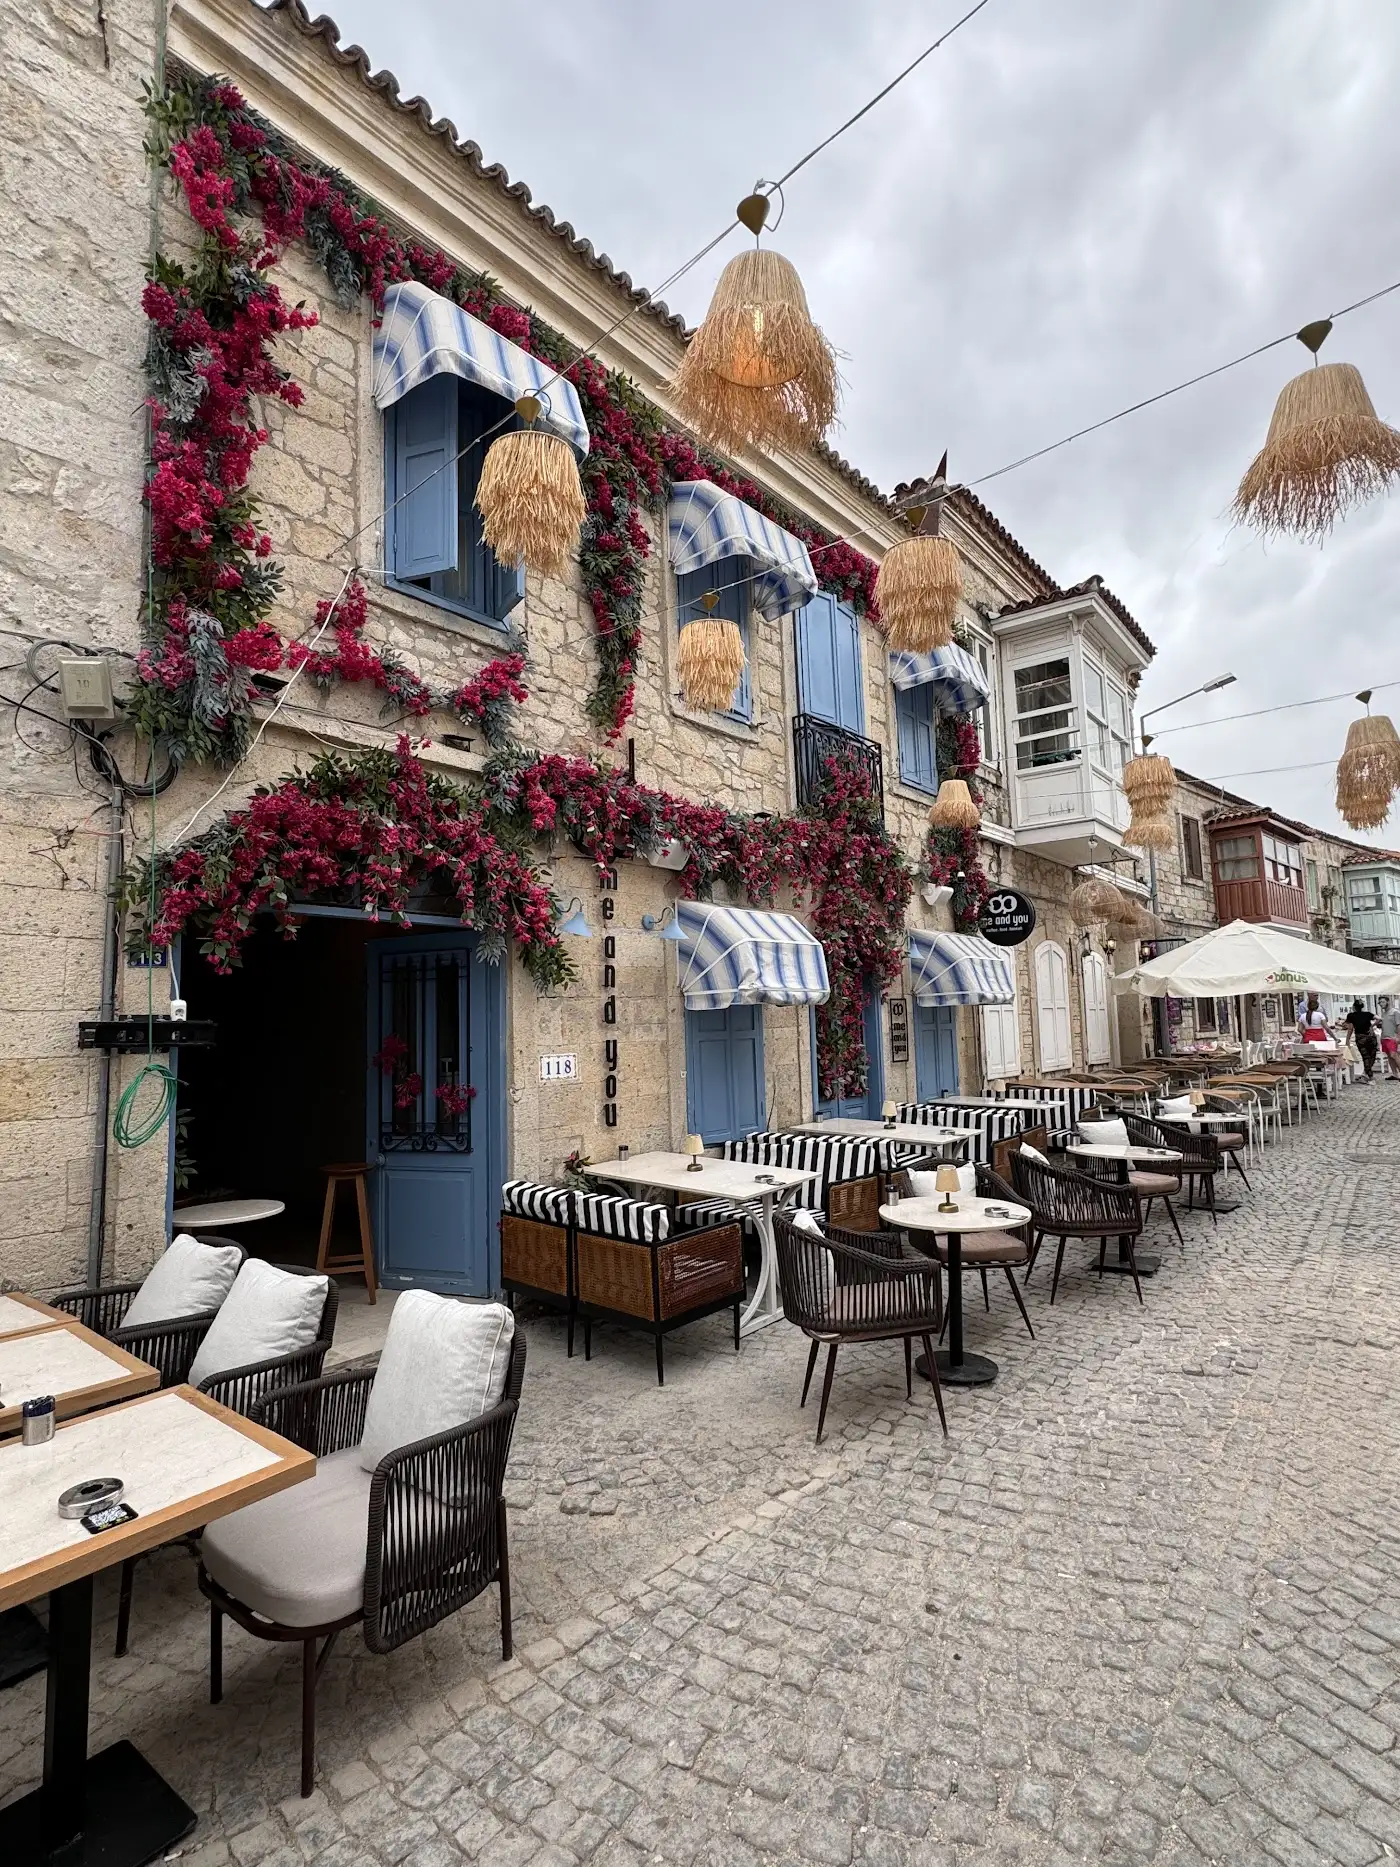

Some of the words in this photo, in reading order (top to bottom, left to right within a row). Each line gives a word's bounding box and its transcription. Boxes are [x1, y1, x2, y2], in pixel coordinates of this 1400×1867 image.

[600, 867, 618, 920] me
[995, 914, 1011, 925] and
[1012, 914, 1029, 926] you
[603, 935, 617, 1024] and
[1274, 972, 1309, 983] bonus
[546, 1059, 572, 1076] 118
[604, 1039, 618, 1127] you
